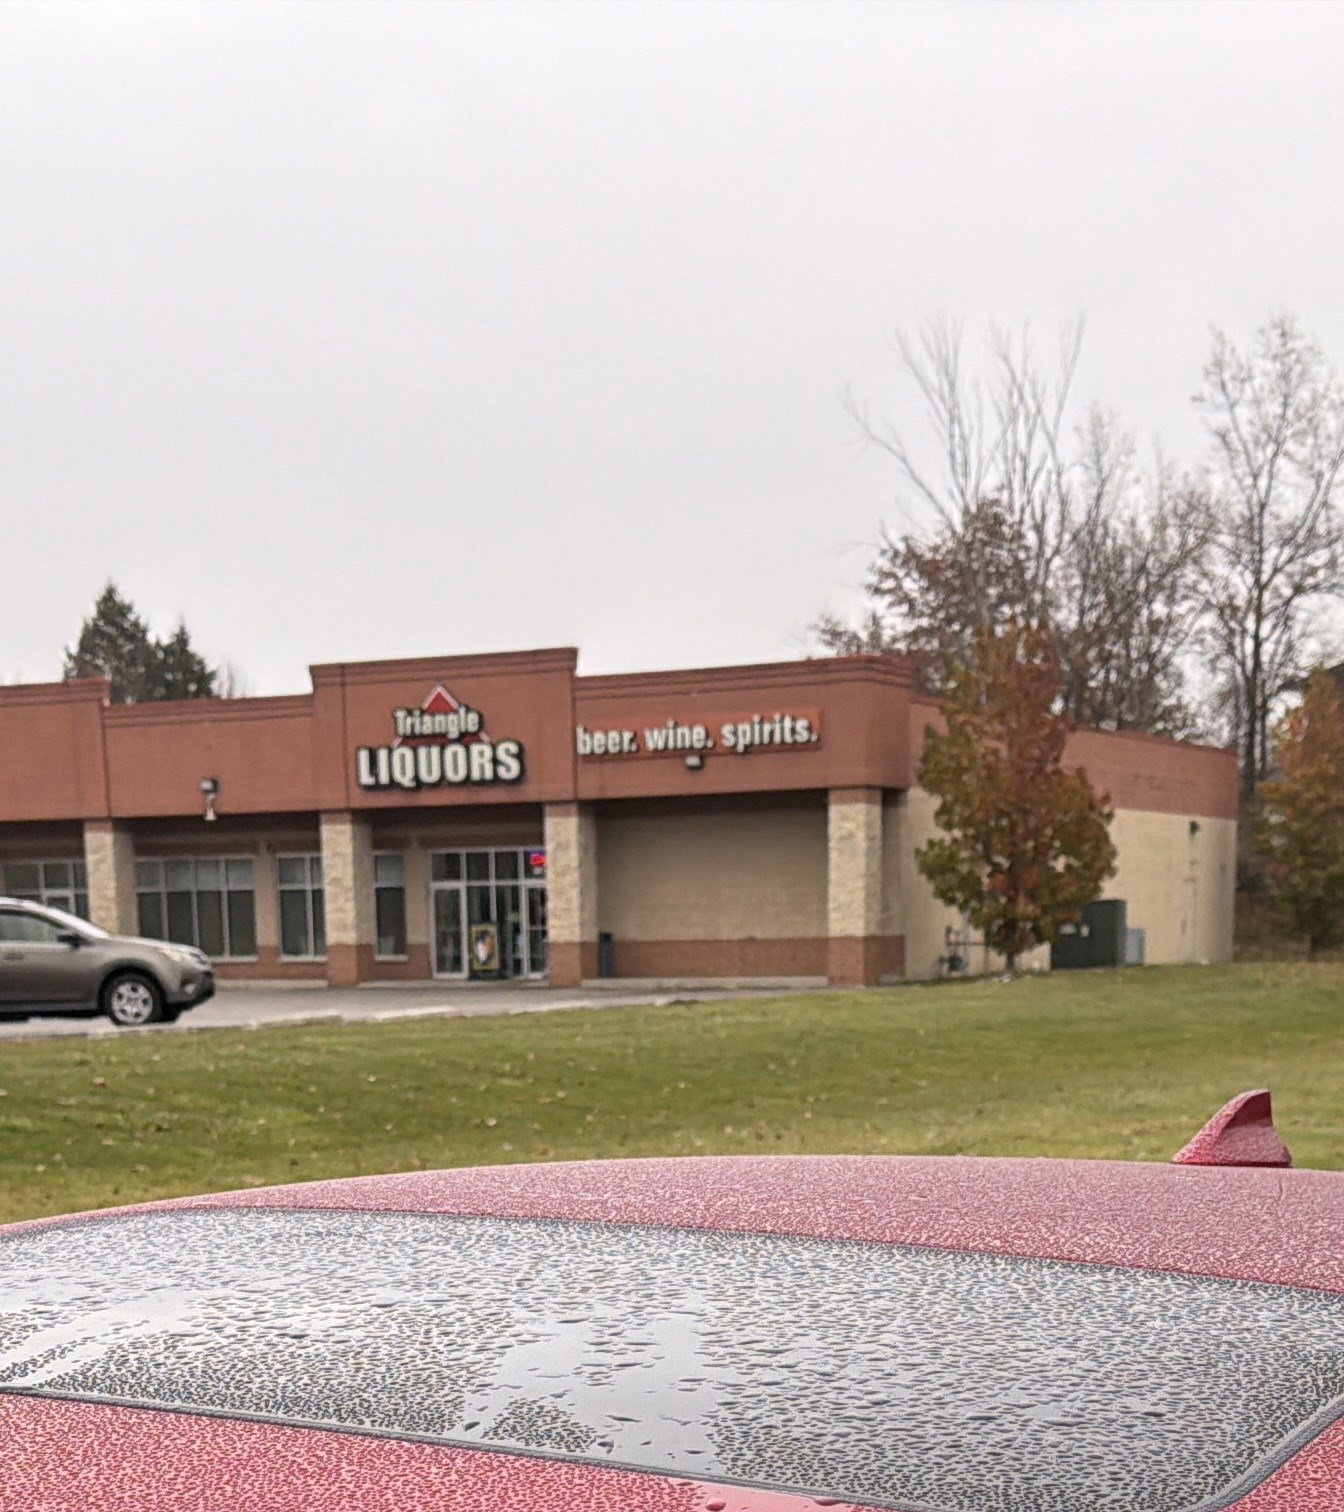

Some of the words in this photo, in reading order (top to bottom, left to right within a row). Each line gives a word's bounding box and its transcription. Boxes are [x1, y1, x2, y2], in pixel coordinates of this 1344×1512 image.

[394, 705, 481, 739] Triangle
[576, 724, 637, 755] beer.
[644, 717, 713, 751] wine.
[721, 713, 818, 752] spirits.
[358, 740, 522, 788] LIQUORS
